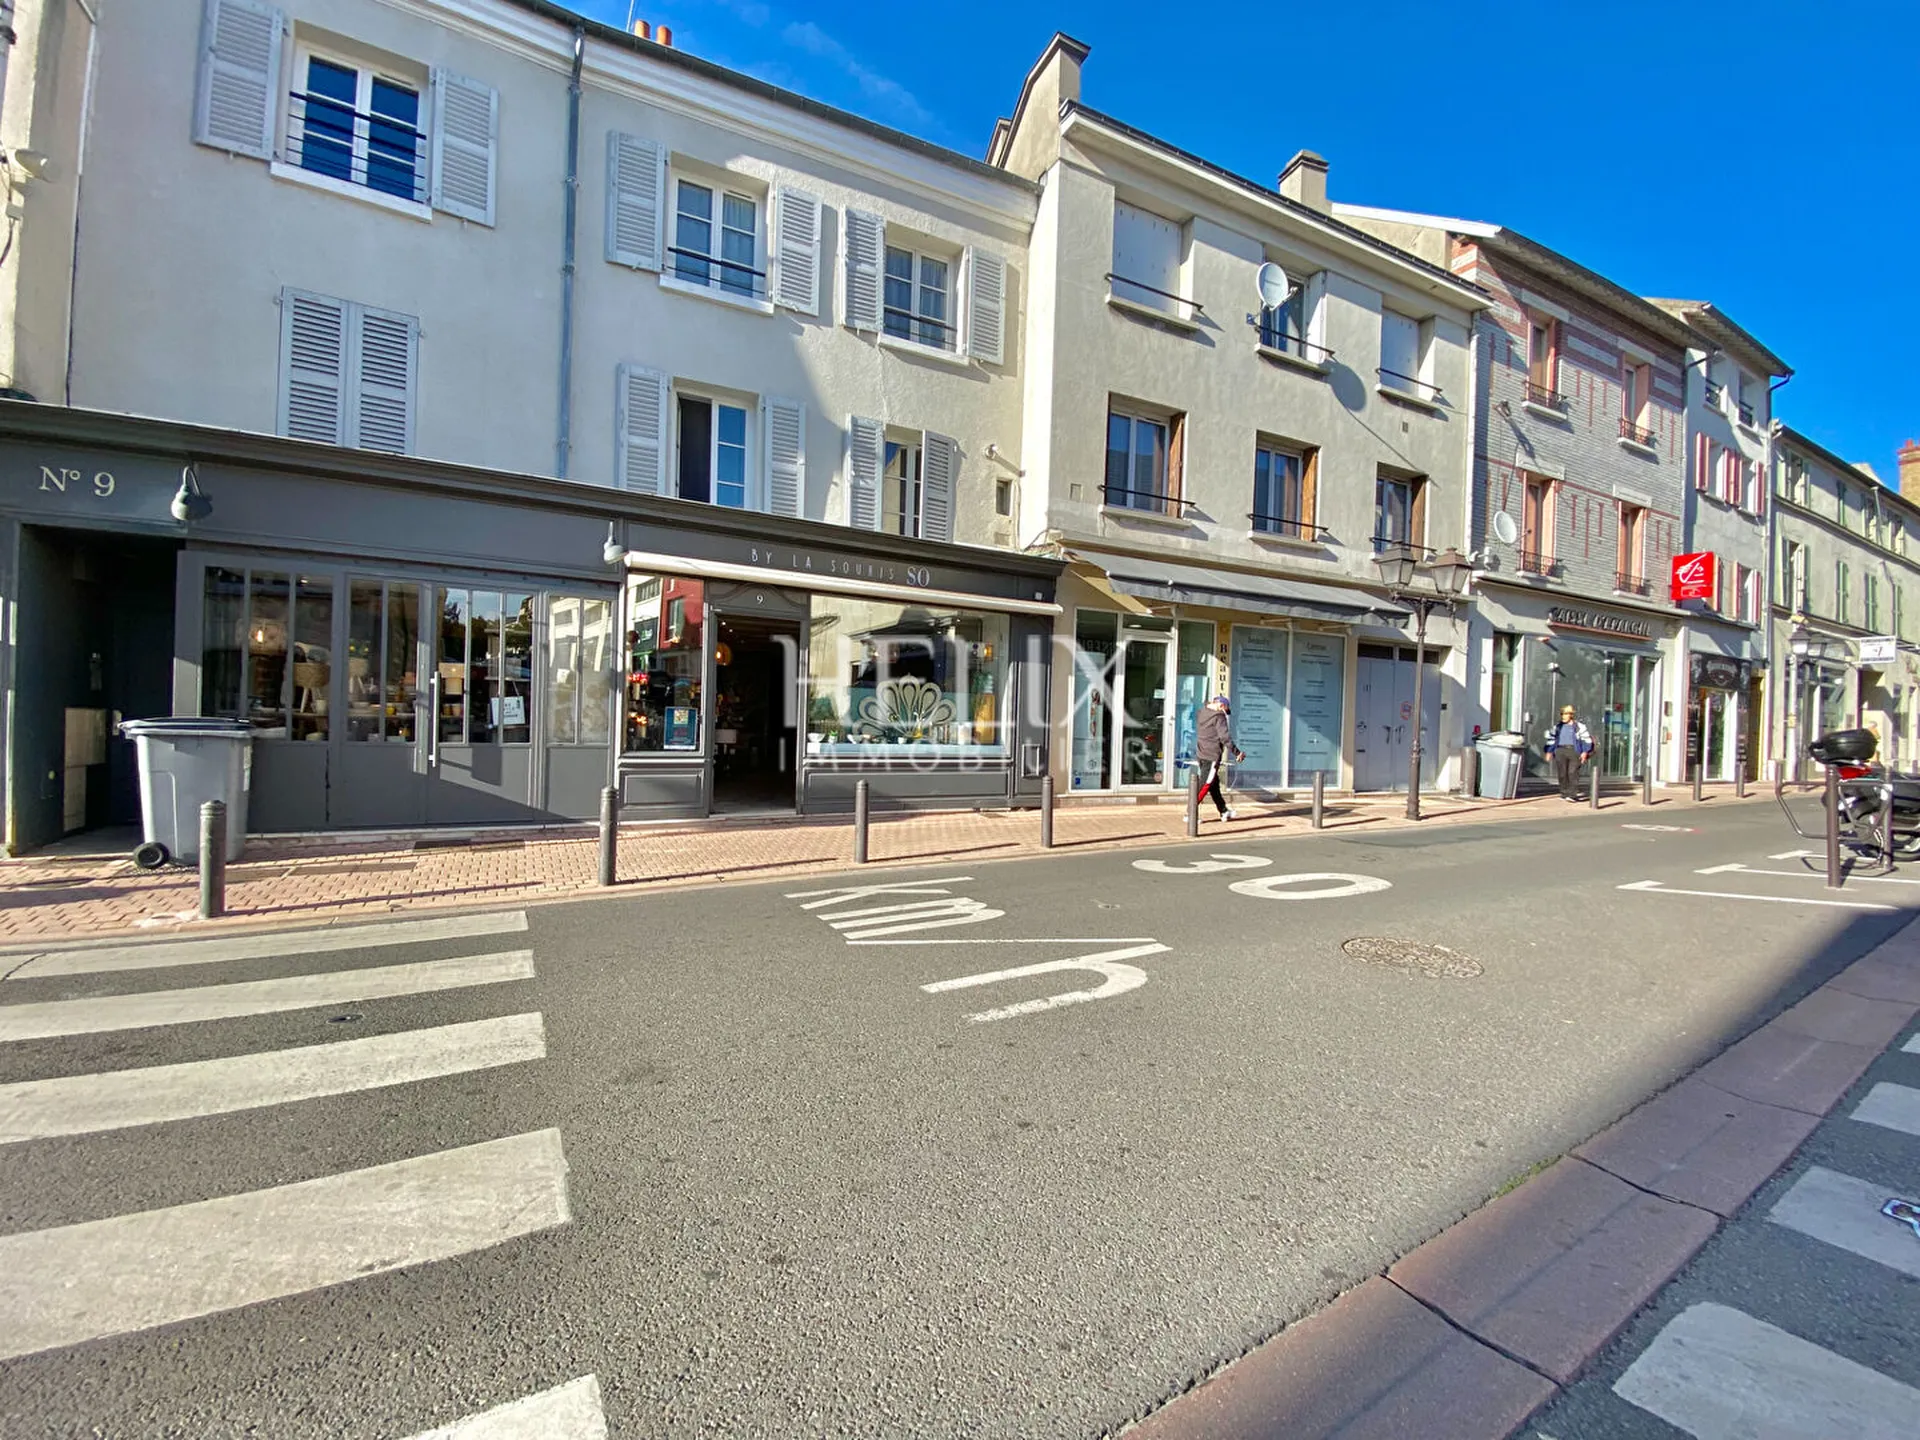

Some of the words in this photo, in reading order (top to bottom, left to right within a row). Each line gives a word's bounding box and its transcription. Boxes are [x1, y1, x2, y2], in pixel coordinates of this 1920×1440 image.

[93, 471, 116, 498] 9
[751, 548, 773, 565] BY
[792, 554, 813, 570] LA
[831, 559, 895, 581] SOURIS
[906, 566, 931, 588] SO
[756, 593, 764, 605] 9
[1132, 854, 1392, 901] 30
